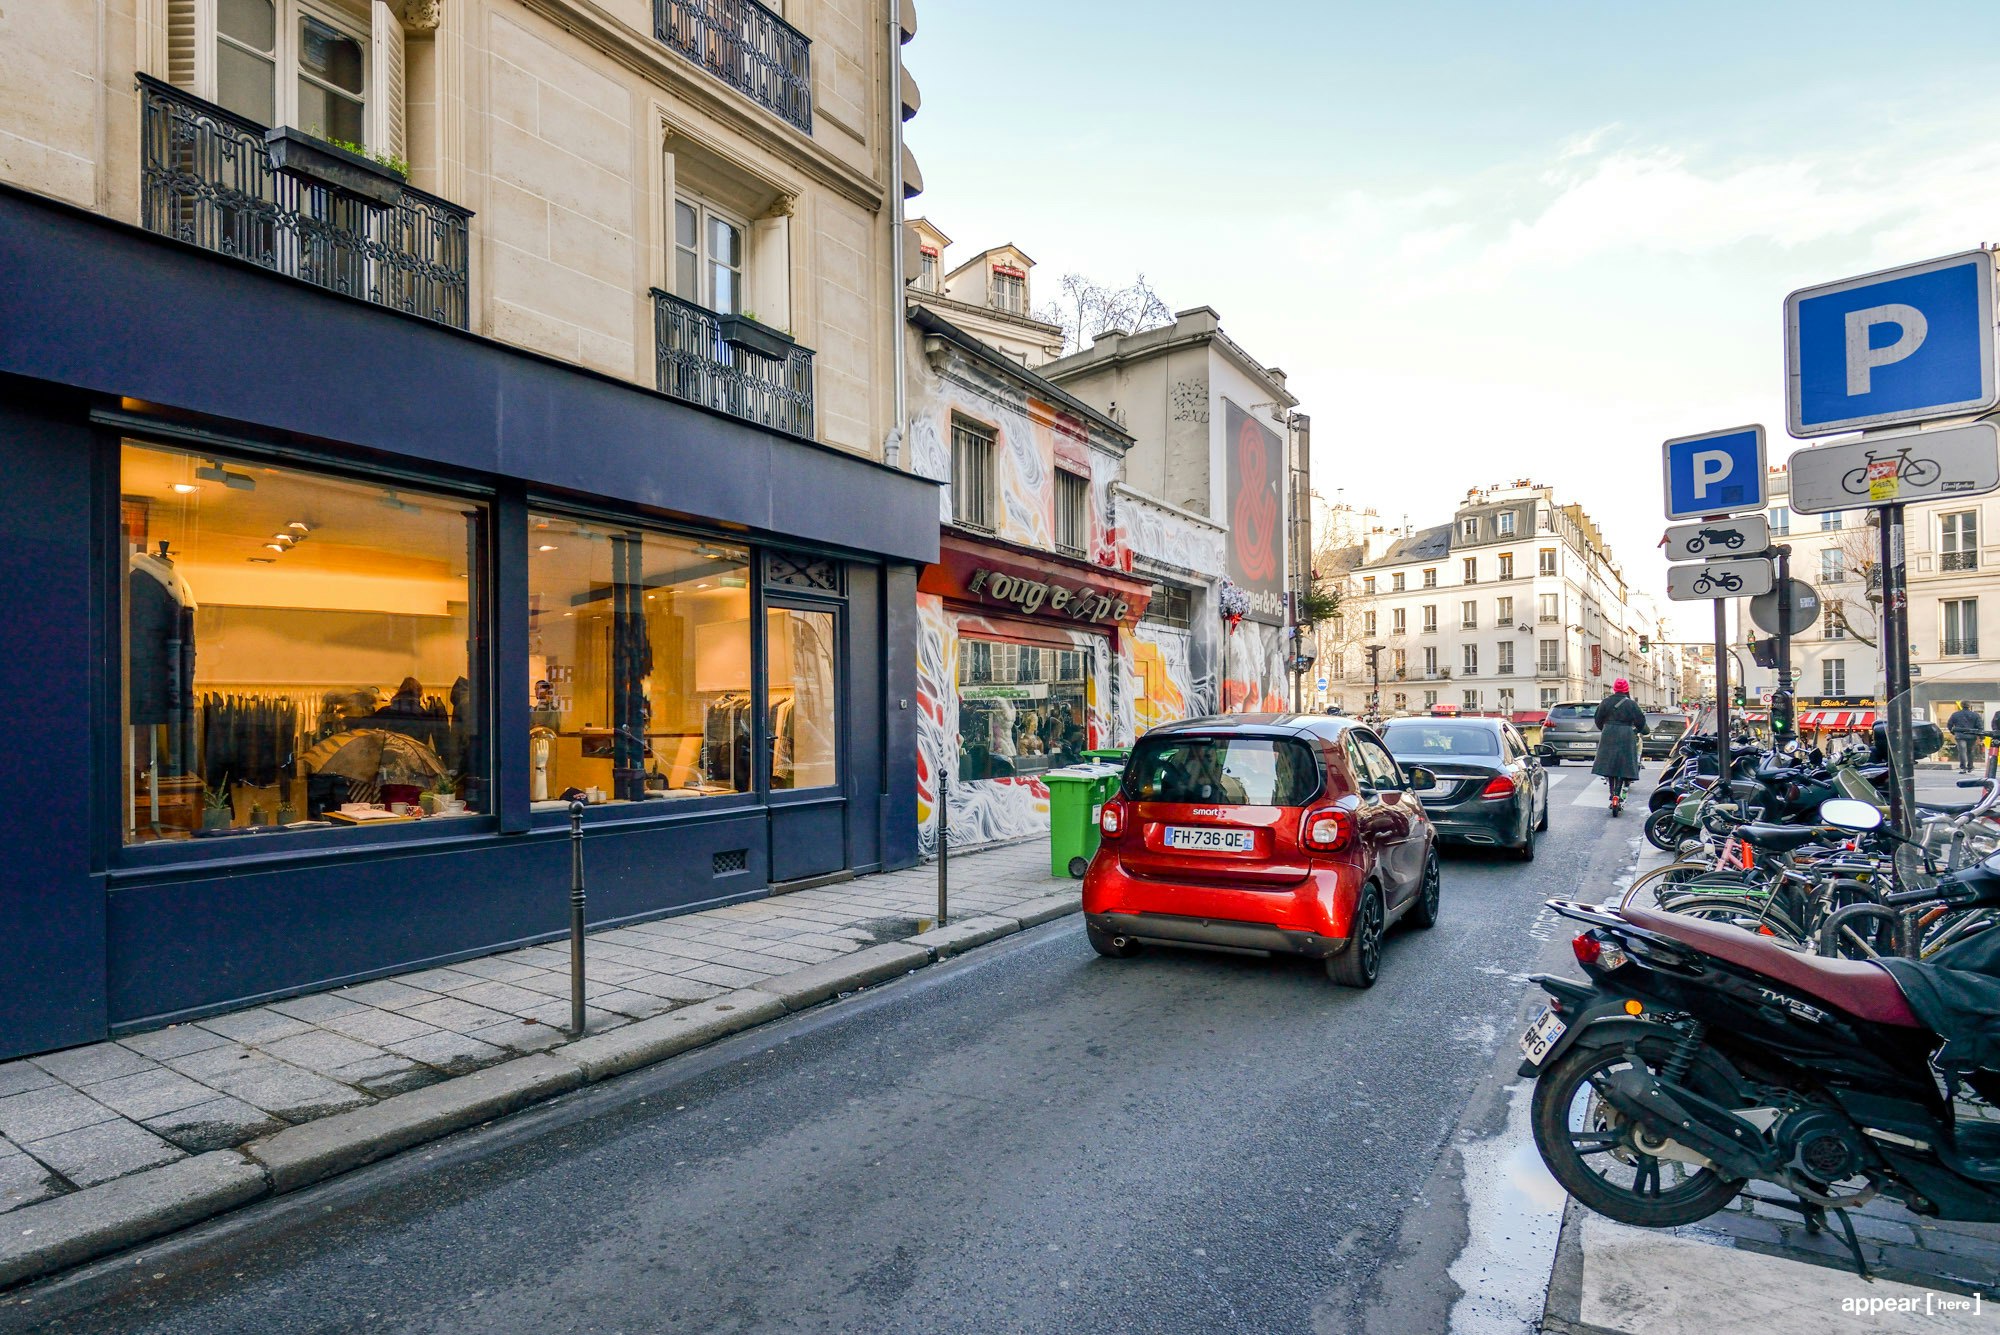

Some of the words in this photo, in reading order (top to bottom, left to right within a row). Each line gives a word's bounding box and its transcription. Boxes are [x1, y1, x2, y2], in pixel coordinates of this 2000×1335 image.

[1845, 303, 1928, 397] P
[1693, 449, 1734, 499] P
[1193, 808, 1218, 816] smart
[1173, 830, 1243, 847] FH-736-QE
[1758, 988, 1829, 1019] TWEET
